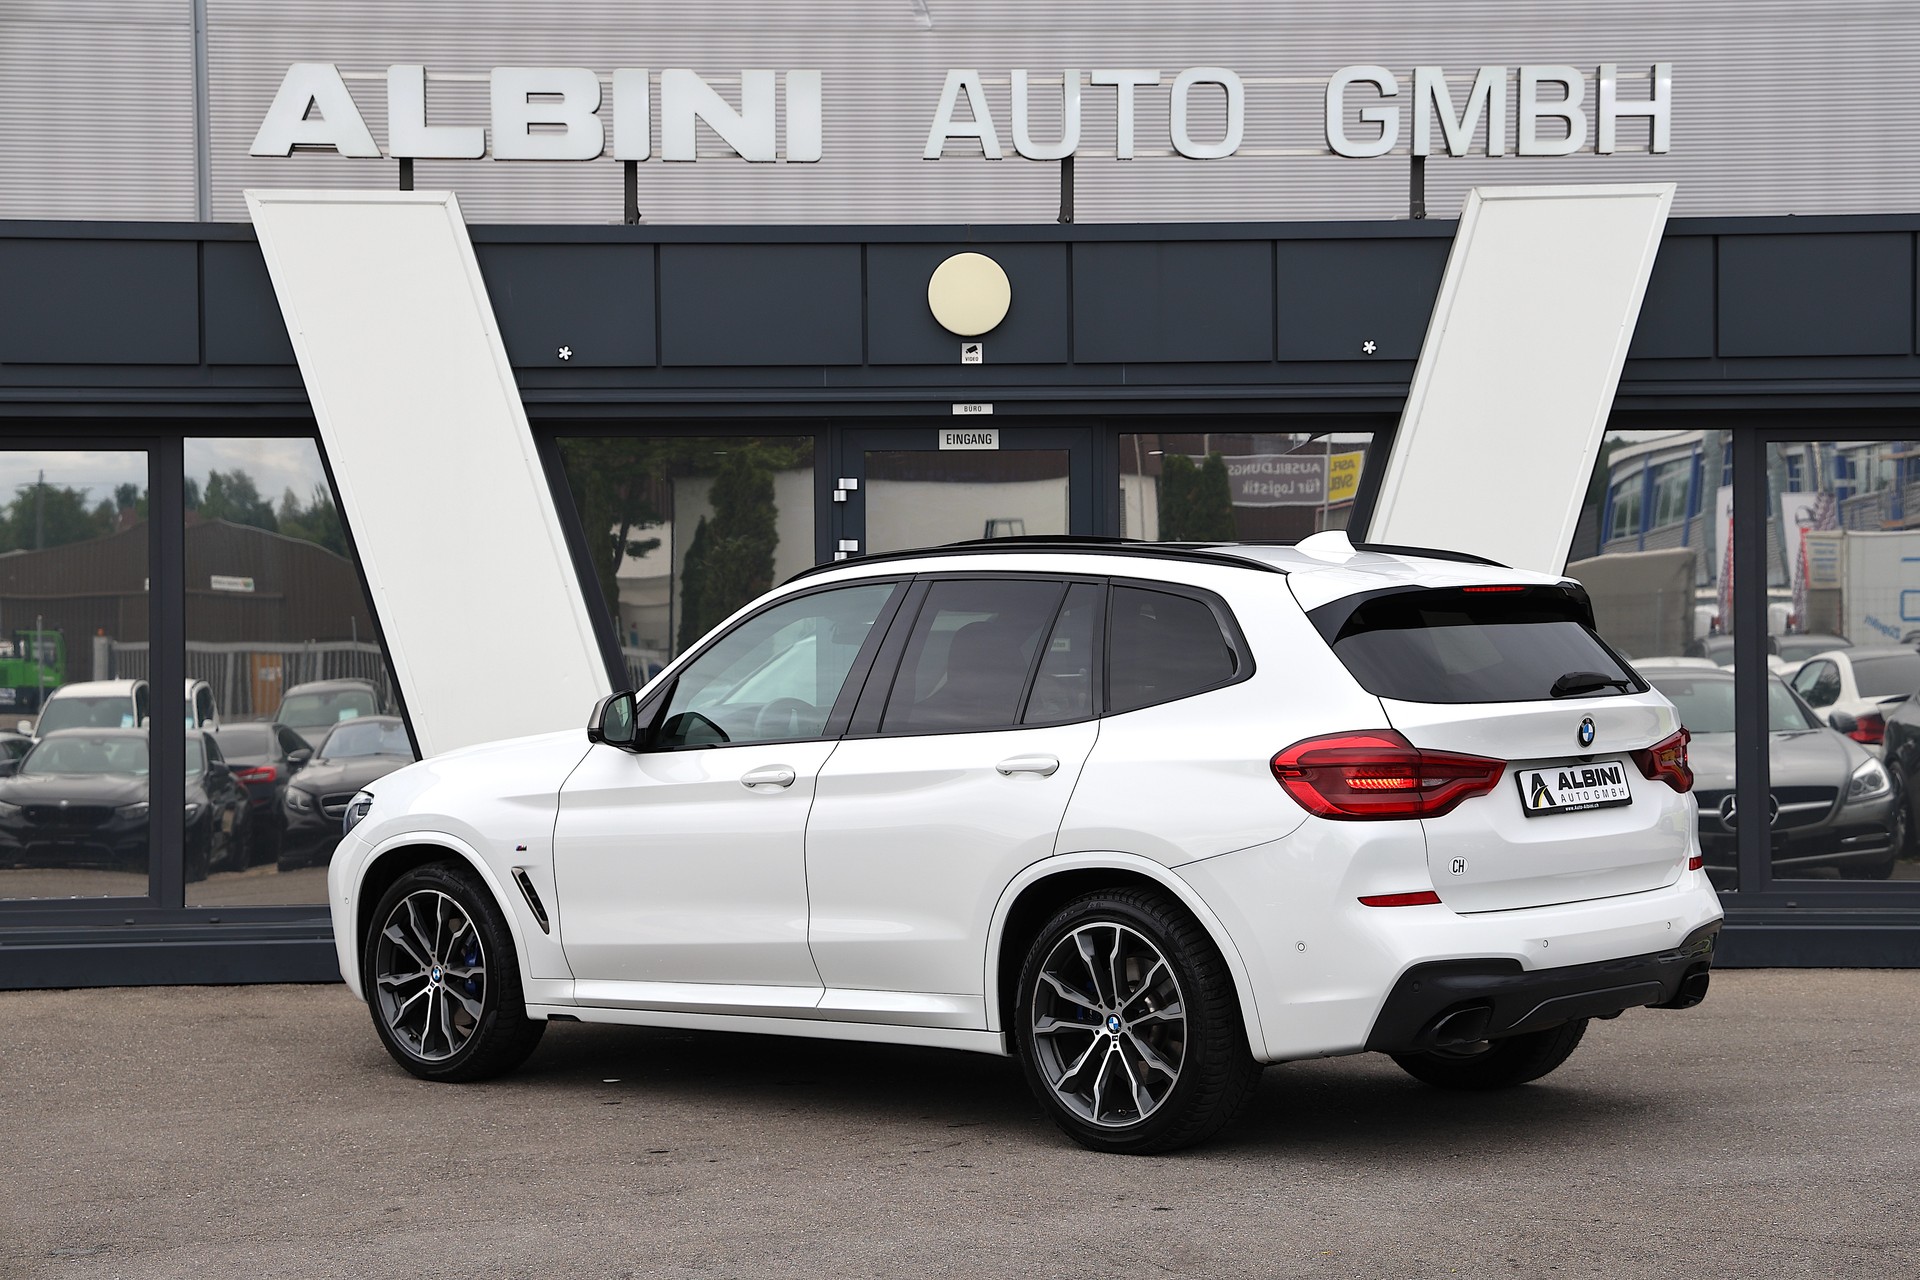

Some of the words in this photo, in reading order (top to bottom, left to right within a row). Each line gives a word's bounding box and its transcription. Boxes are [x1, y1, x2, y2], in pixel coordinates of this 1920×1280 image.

[249, 62, 822, 164] ALBINI
[922, 66, 1245, 162] AUTO
[1324, 62, 1672, 158] GMBH
[963, 404, 982, 412] BÜRO
[946, 433, 992, 445] EINGANG
[1558, 766, 1621, 790] ALBINI
[1560, 790, 1590, 803] AUTO
[1594, 787, 1626, 799] GMBH
[1452, 859, 1465, 873] CH
